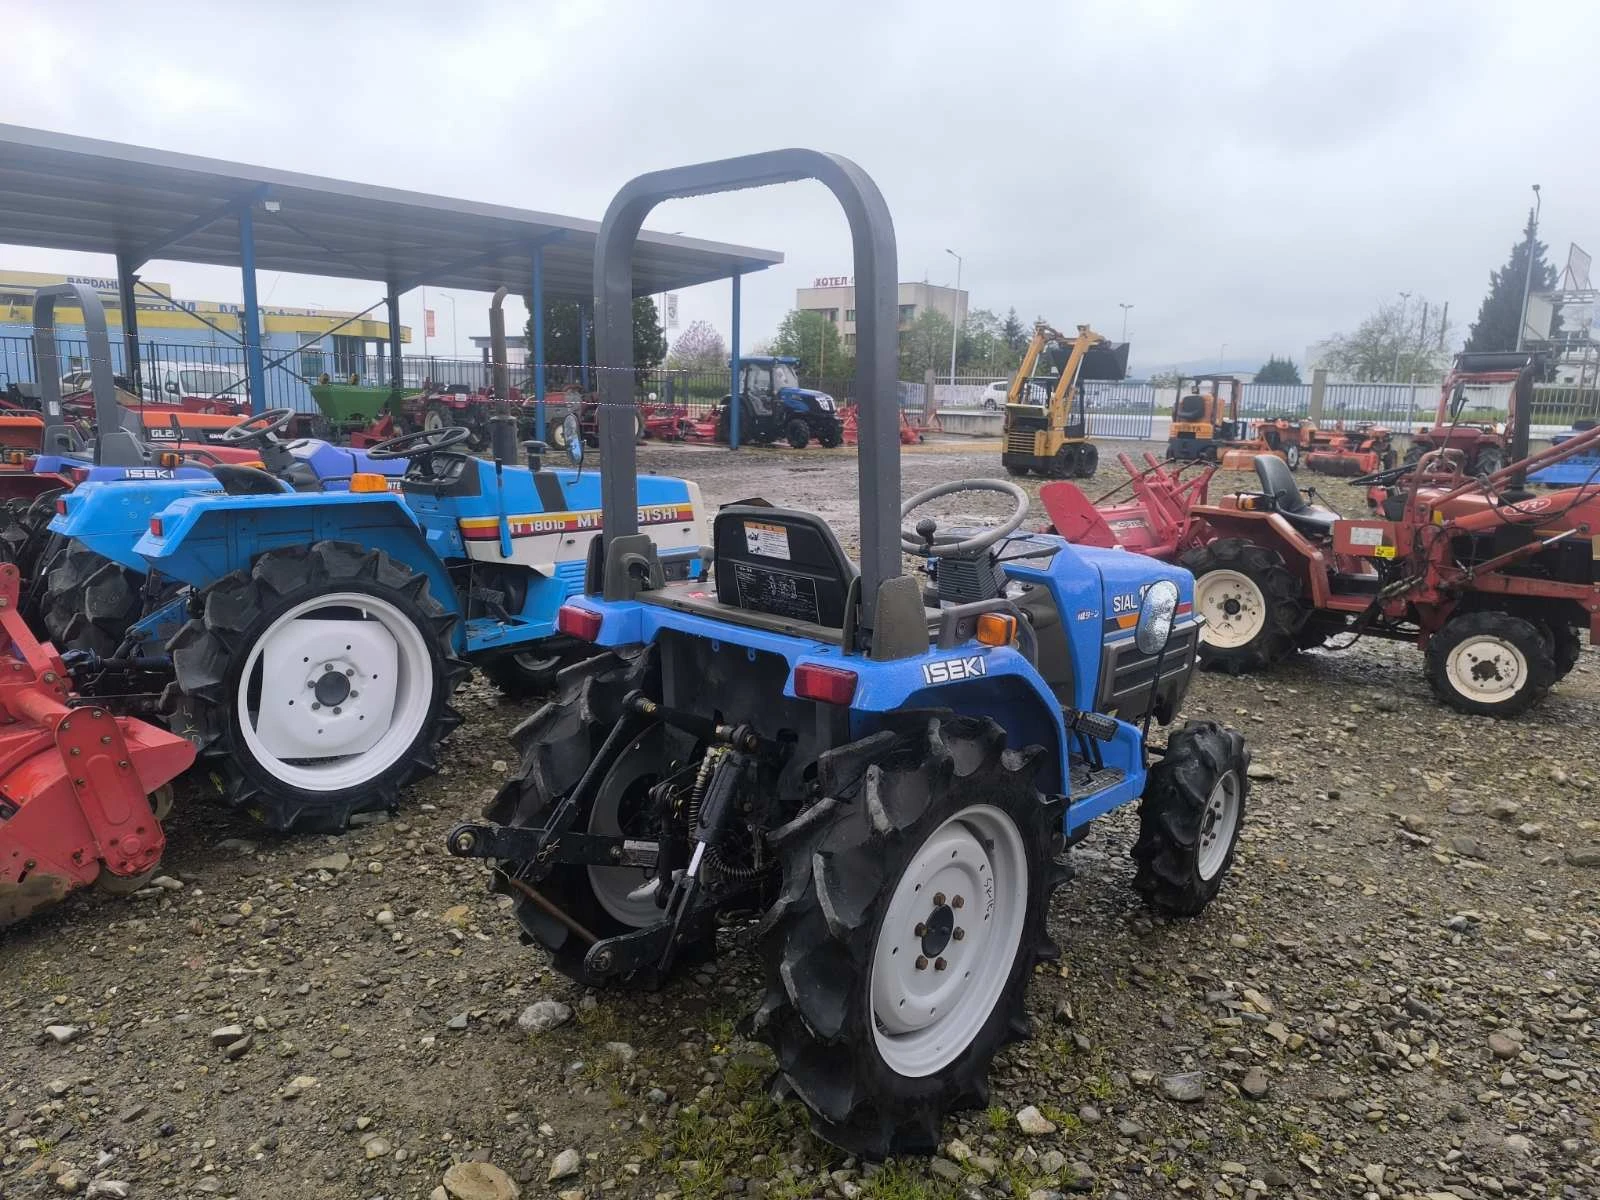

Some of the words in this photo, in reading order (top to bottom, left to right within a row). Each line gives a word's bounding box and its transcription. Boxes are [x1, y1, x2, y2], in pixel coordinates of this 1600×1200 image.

[815, 276, 848, 287] ХОТЕЛ
[124, 469, 175, 479] ISEKI
[577, 508, 678, 528] MIBISHI
[1113, 594, 1138, 612] SIAL
[922, 655, 987, 684] ISEKI
